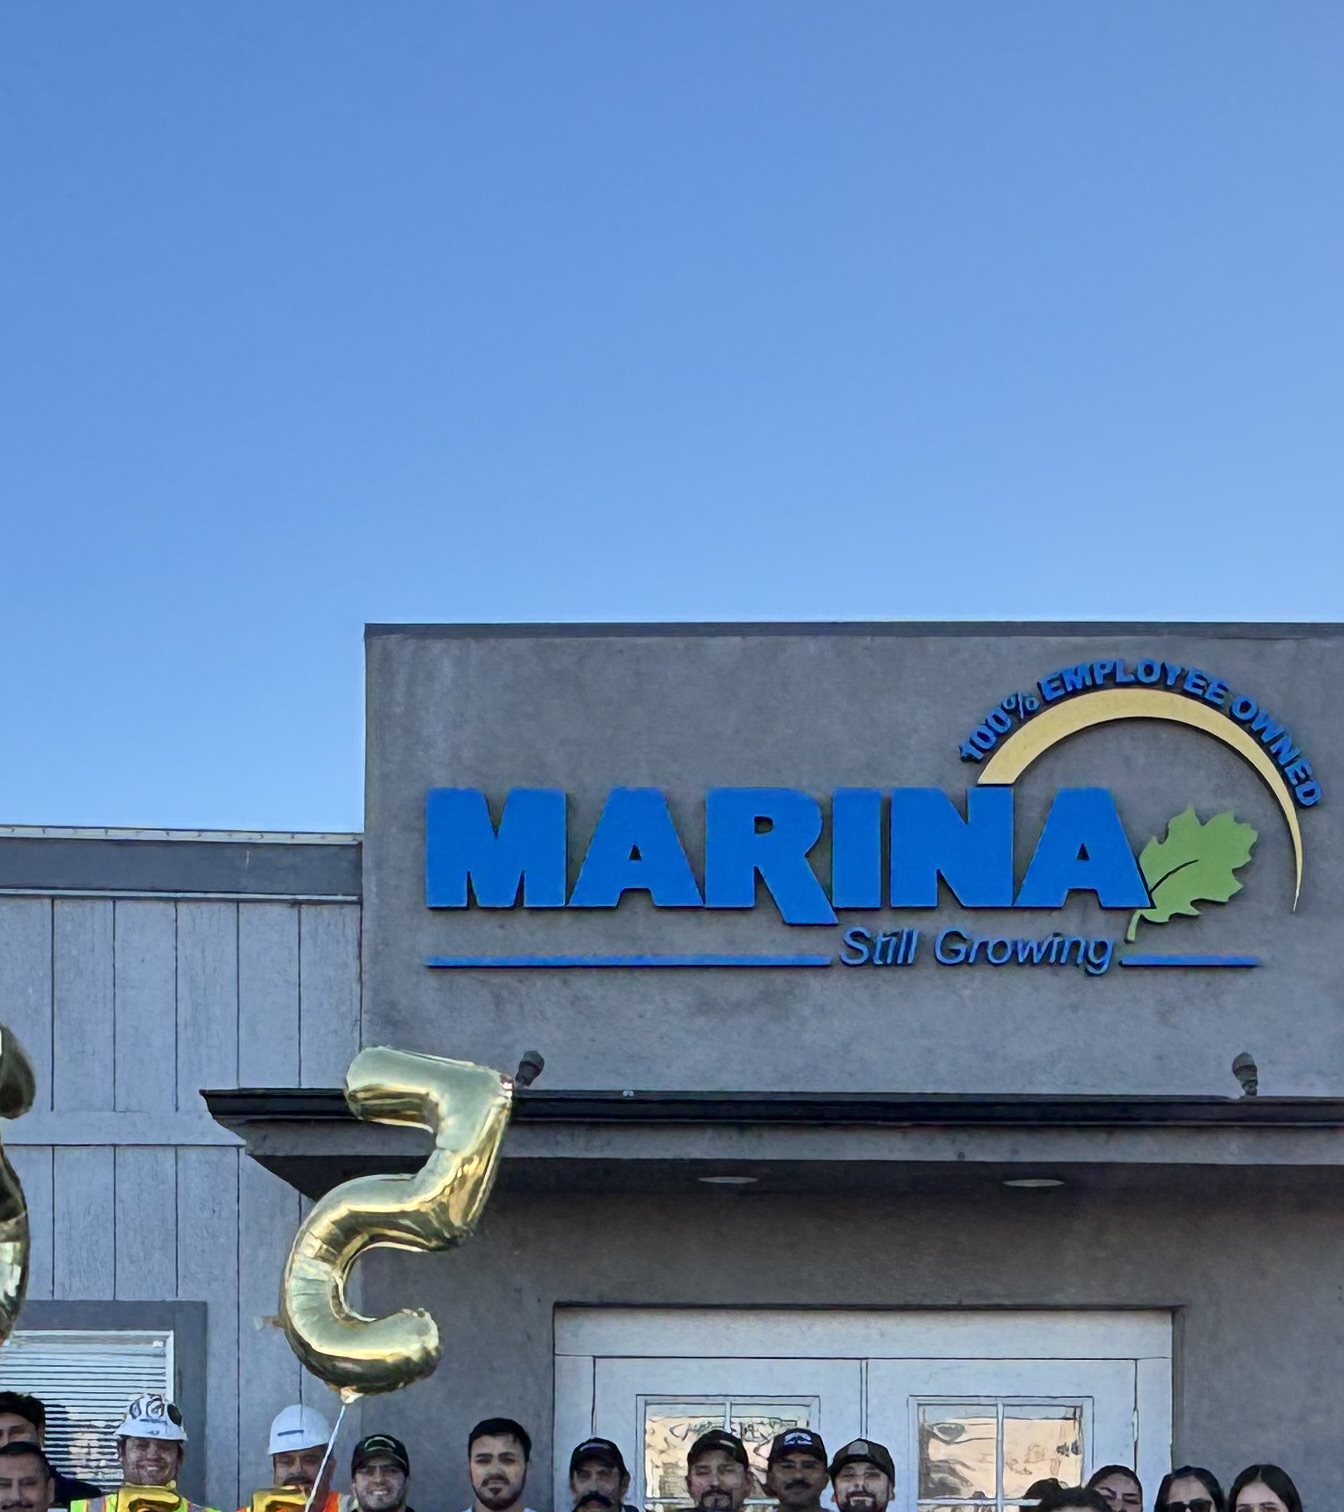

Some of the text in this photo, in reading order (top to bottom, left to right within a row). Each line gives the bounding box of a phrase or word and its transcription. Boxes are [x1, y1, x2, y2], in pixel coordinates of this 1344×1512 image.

[959, 657, 1324, 807] 100% EMPLOYEE OWNED
[425, 786, 1149, 926] MARINA
[839, 926, 1115, 976] Still Growing
